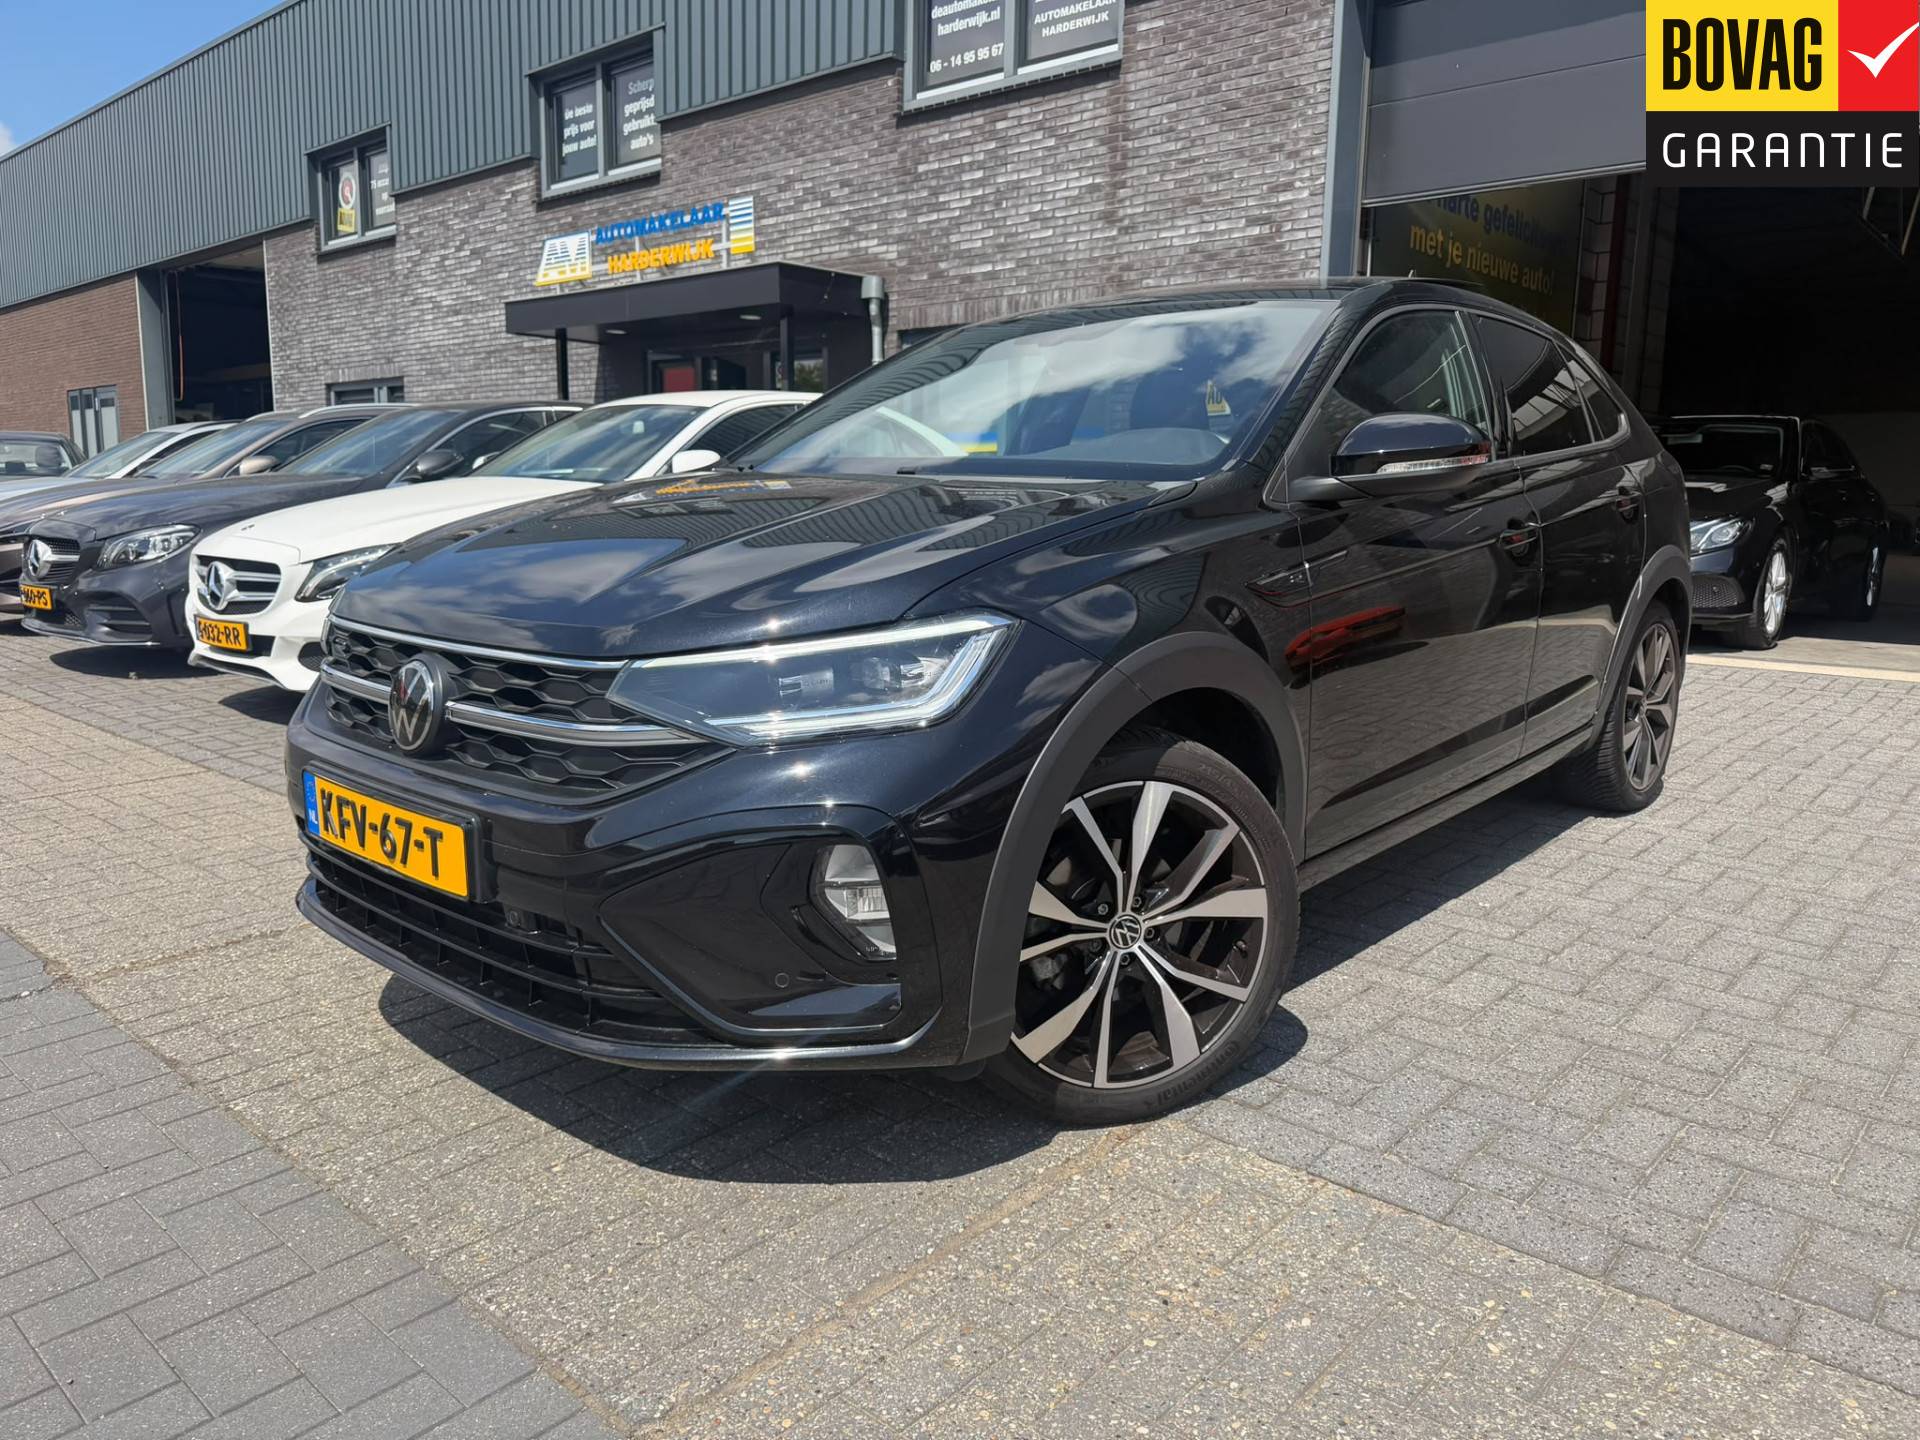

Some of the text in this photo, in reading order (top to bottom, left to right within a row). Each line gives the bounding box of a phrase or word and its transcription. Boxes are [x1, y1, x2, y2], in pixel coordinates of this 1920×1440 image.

[937, 6, 1000, 36] harderwijk.nl
[1042, 11, 1109, 37] HARDERWIJK
[930, 58, 943, 73] 06
[950, 55, 962, 68] 14
[963, 51, 976, 64] 95
[977, 47, 990, 60] 95
[991, 43, 1005, 56] 67
[595, 202, 725, 245] AUTOMAKELAAR
[608, 239, 715, 275] HARDERWIJK
[1410, 224, 1444, 259] met
[1446, 232, 1462, 268] je
[1466, 242, 1518, 284] nieuwe
[320, 787, 443, 880] KFV-67-T
